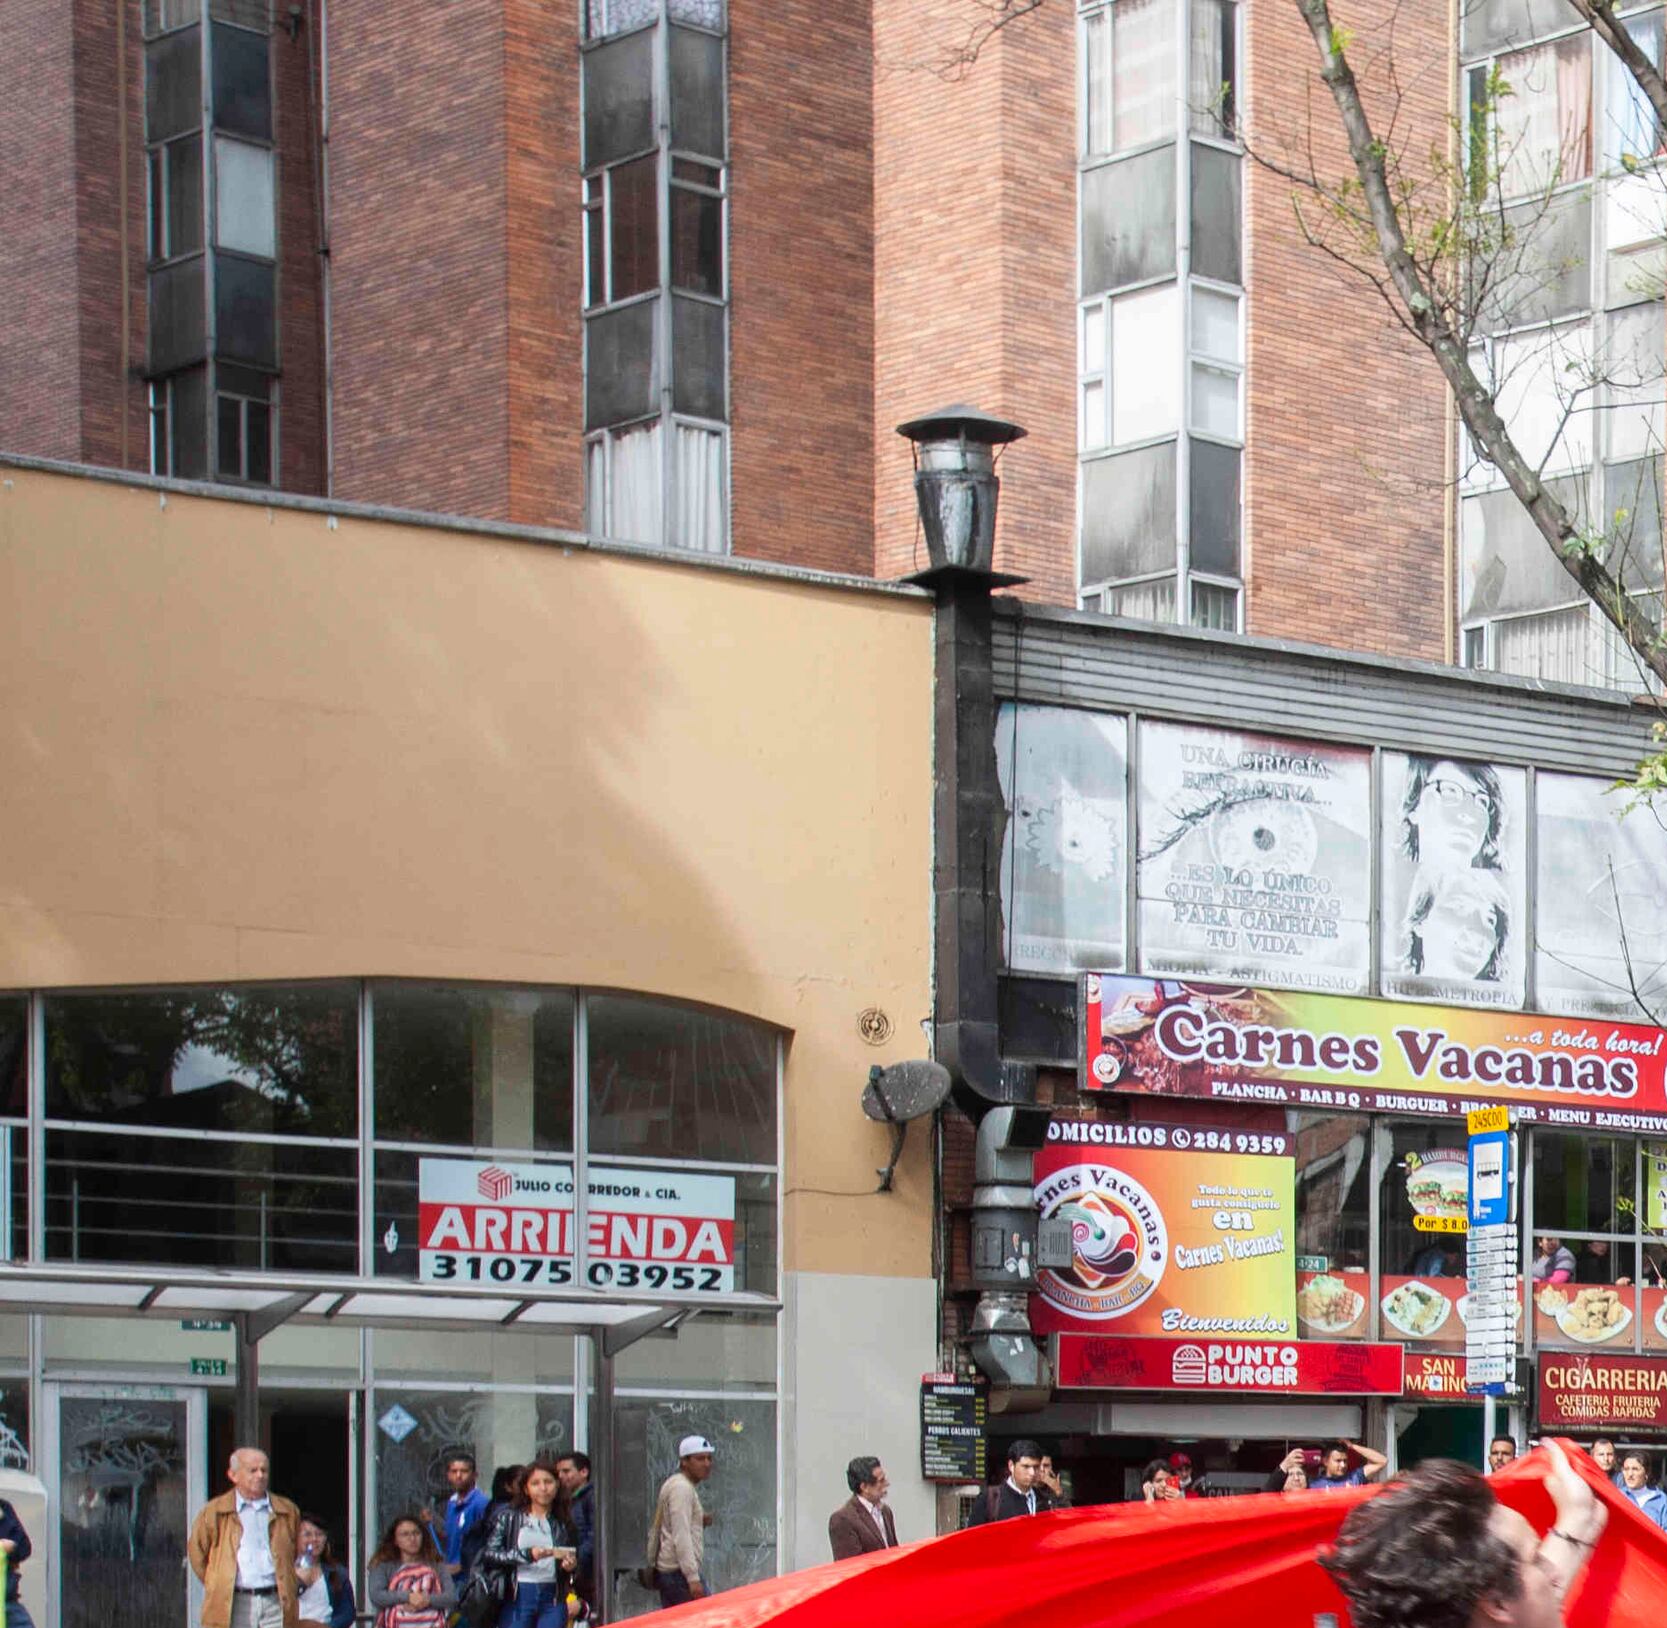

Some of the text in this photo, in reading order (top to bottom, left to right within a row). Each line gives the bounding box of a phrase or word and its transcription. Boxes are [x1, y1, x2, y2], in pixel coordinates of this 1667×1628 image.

[1181, 744, 1231, 767] UNA
[1222, 866, 1254, 887] LO
[1262, 868, 1332, 895] ÚNICO
[1165, 882, 1341, 917] QUE NECESITAS
[1174, 902, 1339, 939] PARA CAMBIAR
[1206, 929, 1238, 950] TU
[1229, 967, 1357, 990] ASTIGMATISMO
[1156, 1003, 1640, 1097] Carnes Vacanas
[1551, 1029, 1599, 1051] toda
[1605, 1030, 1665, 1057] hora!
[1211, 1081, 1288, 1101] PLANCHA
[1376, 1095, 1449, 1113] BURGUER
[1548, 1108, 1591, 1125] MENU
[1047, 1122, 1287, 1155] OMICILIOS 284 9359
[515, 1180, 551, 1192] JULIO
[655, 1189, 681, 1200] CIA.
[1240, 1187, 1259, 1199] que
[1036, 1168, 1161, 1246] rnes Vacanas
[1191, 1198, 1222, 1209] gusta
[1212, 1211, 1255, 1231] en
[1418, 1218, 1437, 1229] Por
[427, 1207, 728, 1263] ARRIENDA
[1175, 1228, 1285, 1270] Carnes Vacanas!
[1161, 1307, 1289, 1332] Bienvenidos
[1207, 1344, 1299, 1366] PUNTO
[1422, 1358, 1456, 1375] SAN
[1207, 1364, 1299, 1387] BURGER
[1405, 1375, 1467, 1393] MAINO
[1555, 1394, 1661, 1409] CAFETERIA FRUTERIA
[1560, 1404, 1657, 1419] COMIDAS RAPIDAS
